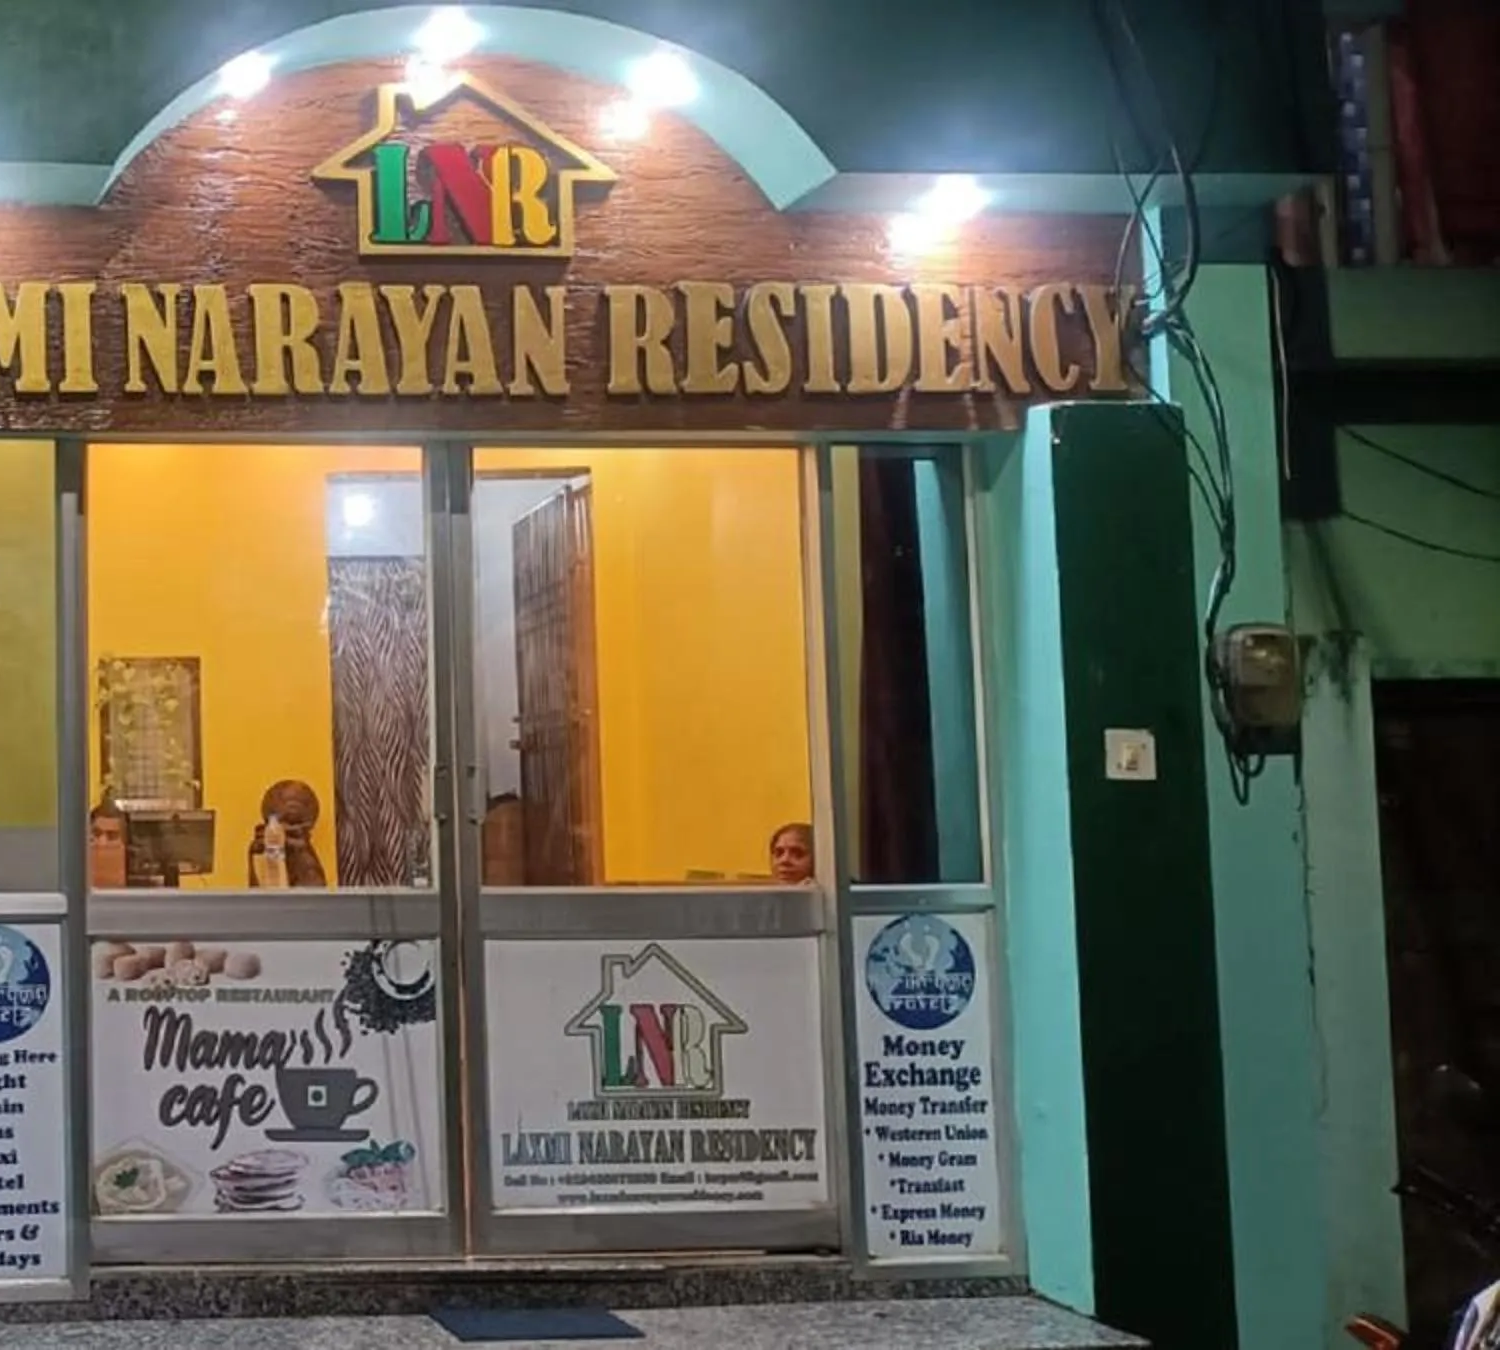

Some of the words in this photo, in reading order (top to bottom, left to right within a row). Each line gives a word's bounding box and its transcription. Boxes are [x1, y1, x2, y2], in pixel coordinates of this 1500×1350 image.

[369, 139, 558, 248] LNR
[120, 281, 572, 397] NARAYAN
[602, 281, 1138, 395] RESIDENCY
[107, 987, 121, 1001] A
[14, 1049, 58, 1064] Here
[600, 1002, 715, 1090] LNR
[882, 1035, 966, 1061] Money
[864, 1060, 982, 1092] Exchange
[158, 1073, 277, 1151] cafe
[864, 1096, 916, 1119] Money
[919, 1095, 989, 1115] Transfer
[944, 1124, 989, 1141] Union
[501, 1131, 572, 1166] LAXMI
[576, 1129, 685, 1165] NARAYAN
[690, 1128, 817, 1163] RESIDENCY
[888, 1151, 935, 1170] Money
[937, 1150, 978, 1166] Gram
[881, 1203, 937, 1224] Express
[940, 1202, 986, 1222] Money
[19, 1223, 41, 1241] &
[900, 1229, 925, 1246] Ria
[927, 1228, 973, 1248] Money
